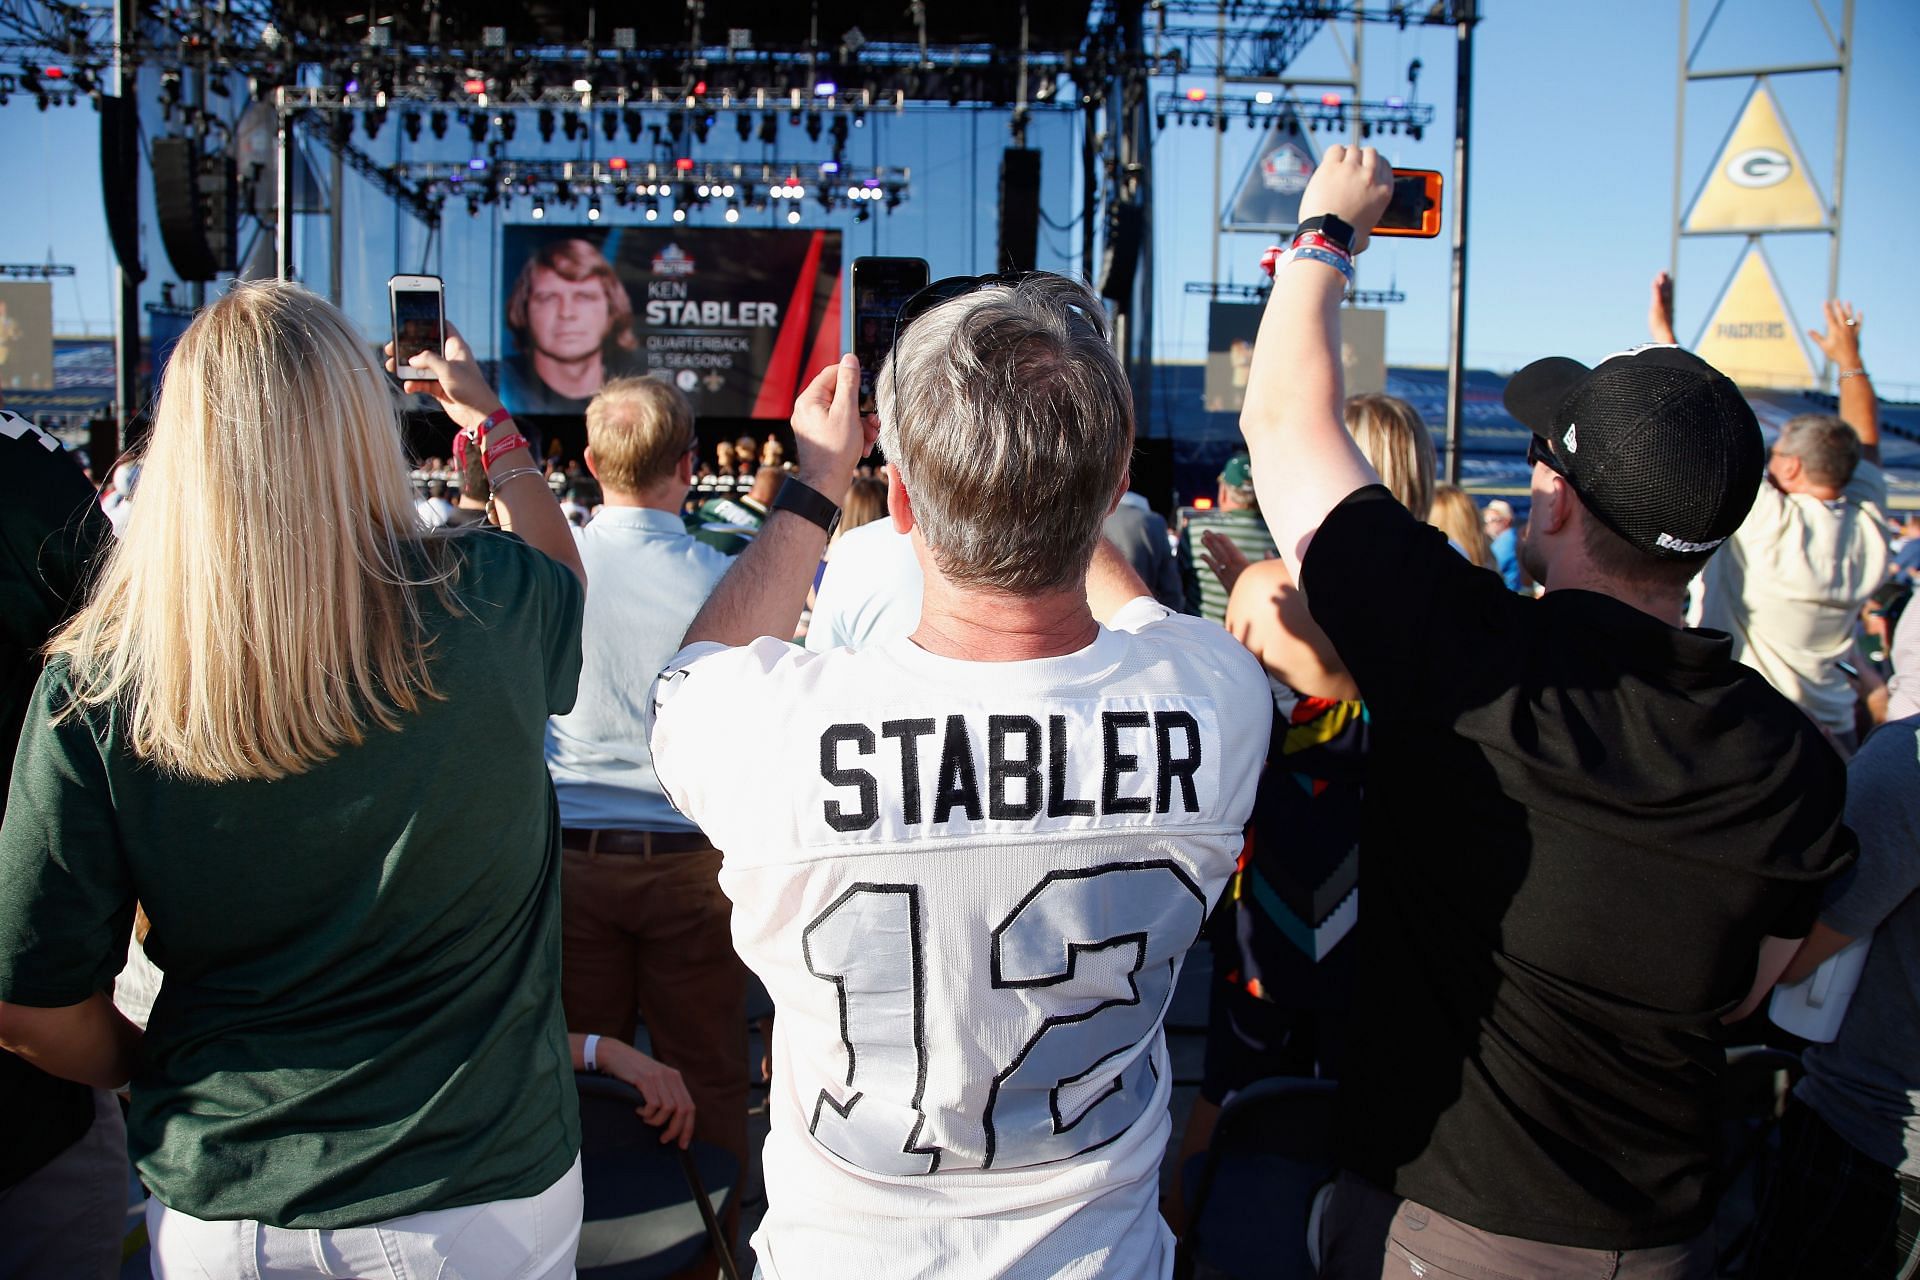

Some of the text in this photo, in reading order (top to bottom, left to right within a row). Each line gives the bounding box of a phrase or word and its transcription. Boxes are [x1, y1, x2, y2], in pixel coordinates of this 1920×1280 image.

[1726, 148, 1792, 188] G
[648, 281, 687, 298] KEN
[645, 300, 778, 327] STABLER
[1717, 322, 1785, 339] PACKERS
[646, 336, 749, 351] QUARTERBACK
[648, 353, 733, 368] 15 SEASONS
[1655, 532, 1728, 553] RAIDER
[820, 711, 1201, 832] STABLER
[802, 859, 1207, 1176] 12
